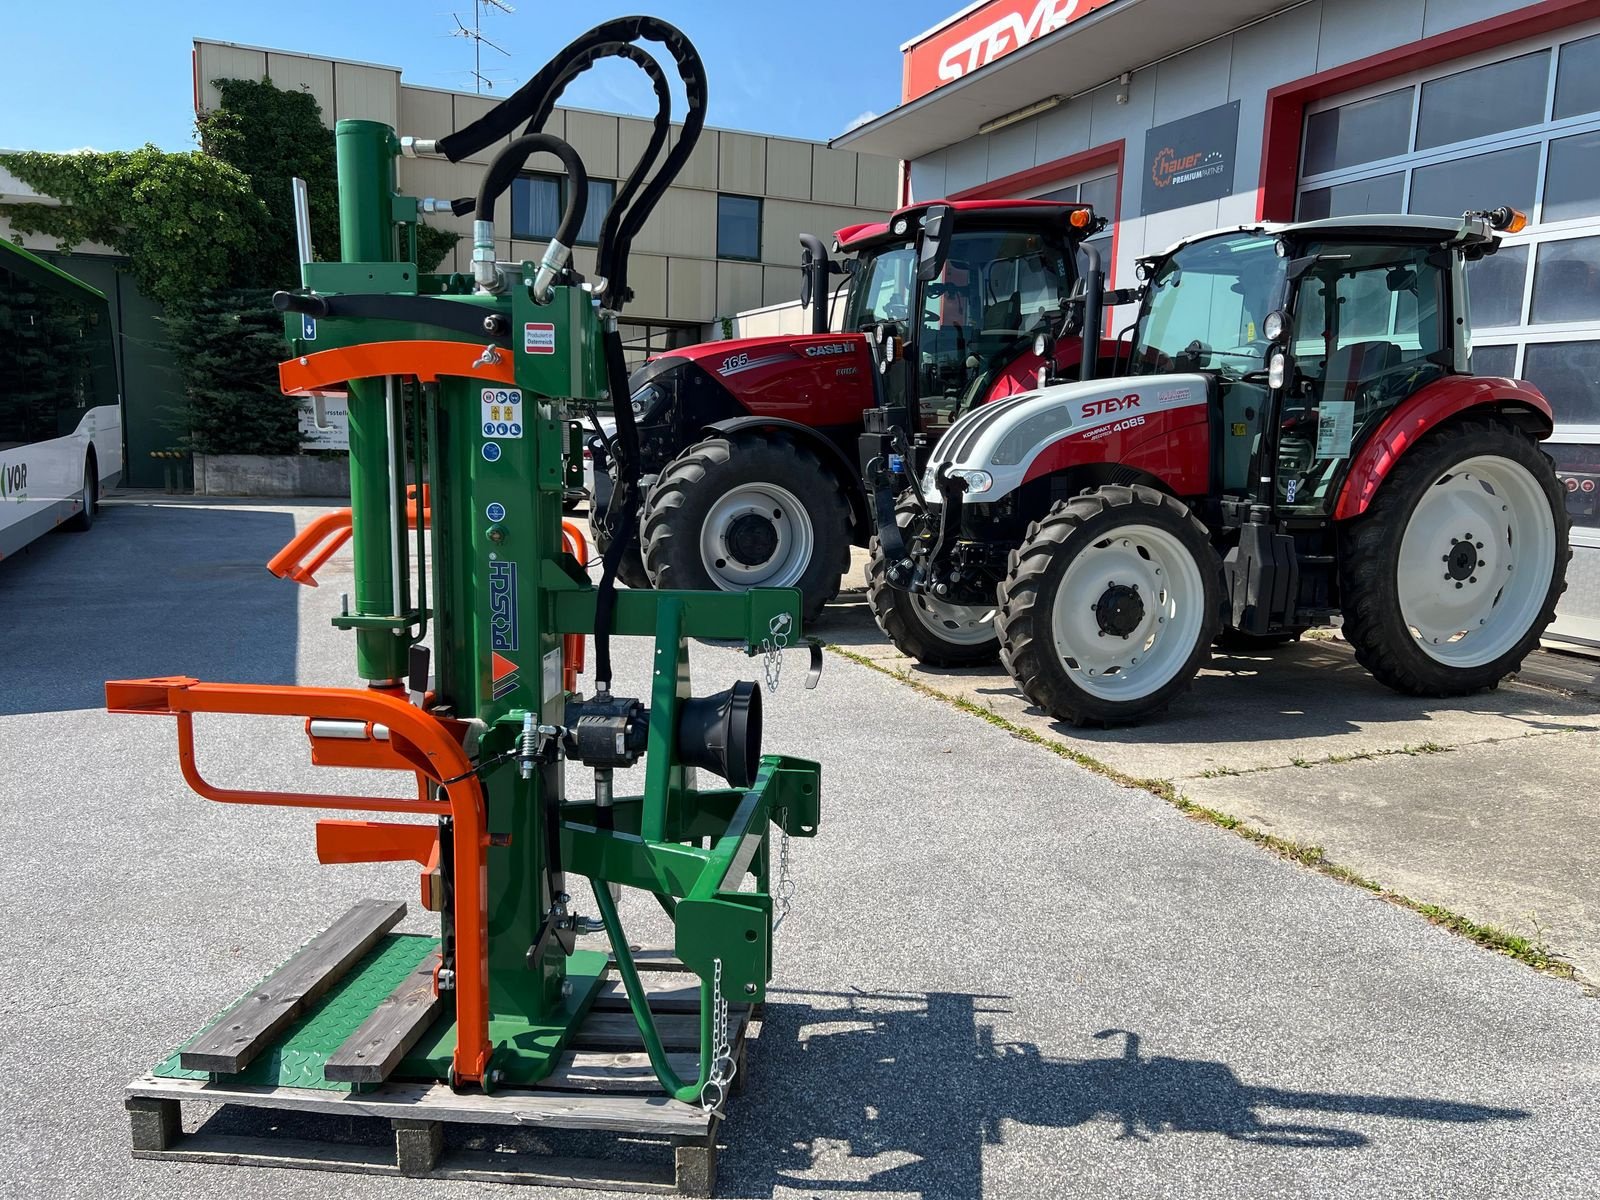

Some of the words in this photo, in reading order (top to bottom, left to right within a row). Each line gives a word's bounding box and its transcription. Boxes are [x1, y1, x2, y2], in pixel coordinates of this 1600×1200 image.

[1160, 153, 1202, 176] hauer
[805, 344, 843, 357] CASE
[1081, 393, 1141, 419] STEYR
[1082, 425, 1112, 439] KOMPAKT
[1113, 416, 1146, 432] 4085
[7, 463, 28, 494] VOR
